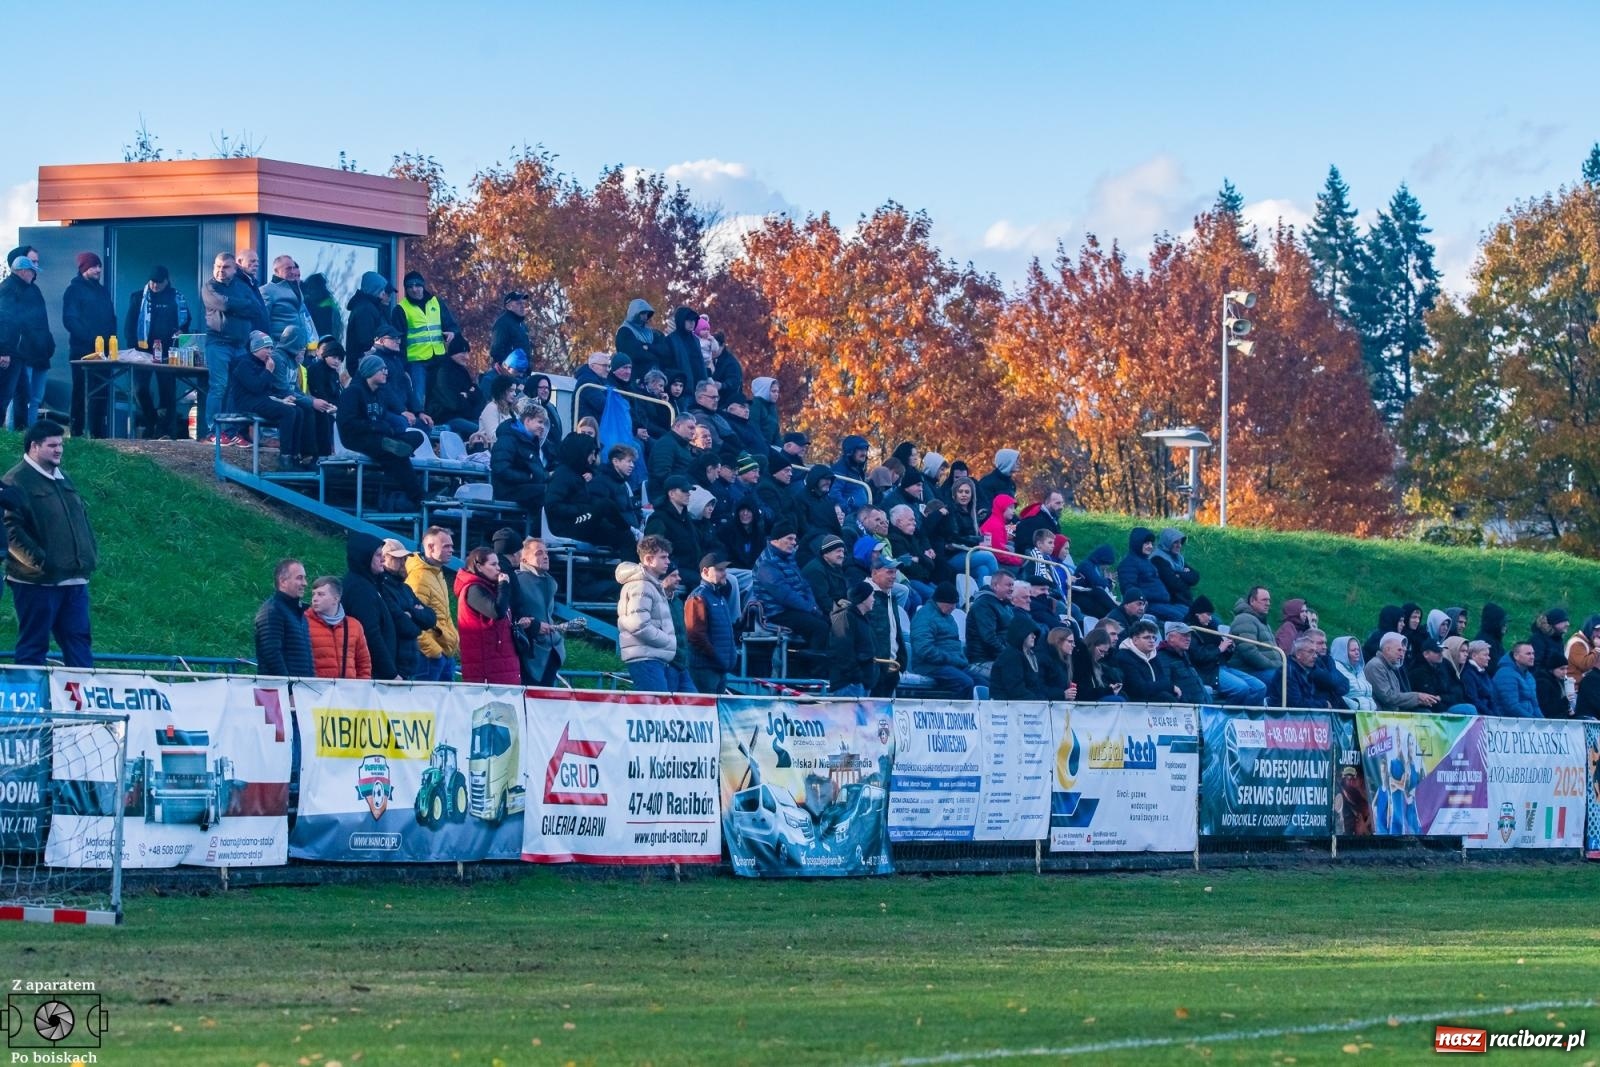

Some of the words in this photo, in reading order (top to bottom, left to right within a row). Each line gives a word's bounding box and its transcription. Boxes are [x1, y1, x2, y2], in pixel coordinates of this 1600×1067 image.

[626, 719, 714, 743] ZAPRASZAMY
[766, 711, 825, 744] Johann
[913, 711, 946, 730] CENTRUM
[321, 716, 431, 750] KIBICUJEMY
[1512, 731, 1570, 755] PIŁKARSKI
[560, 763, 599, 788] GRUD
[628, 756, 644, 779] ul.
[650, 754, 707, 780] Kościuszki
[710, 757, 716, 779] 6
[1253, 759, 1330, 784] PROFESJONALNY
[1553, 766, 1584, 797] 2025
[628, 791, 662, 815] 47-400
[667, 791, 714, 815] Racibórz
[1238, 786, 1274, 806] SERWIS
[22, 816, 38, 833] TIR
[541, 815, 577, 836] GALERIA
[577, 816, 607, 837] BARW
[634, 829, 708, 846] www.grud-raciborz.pl
